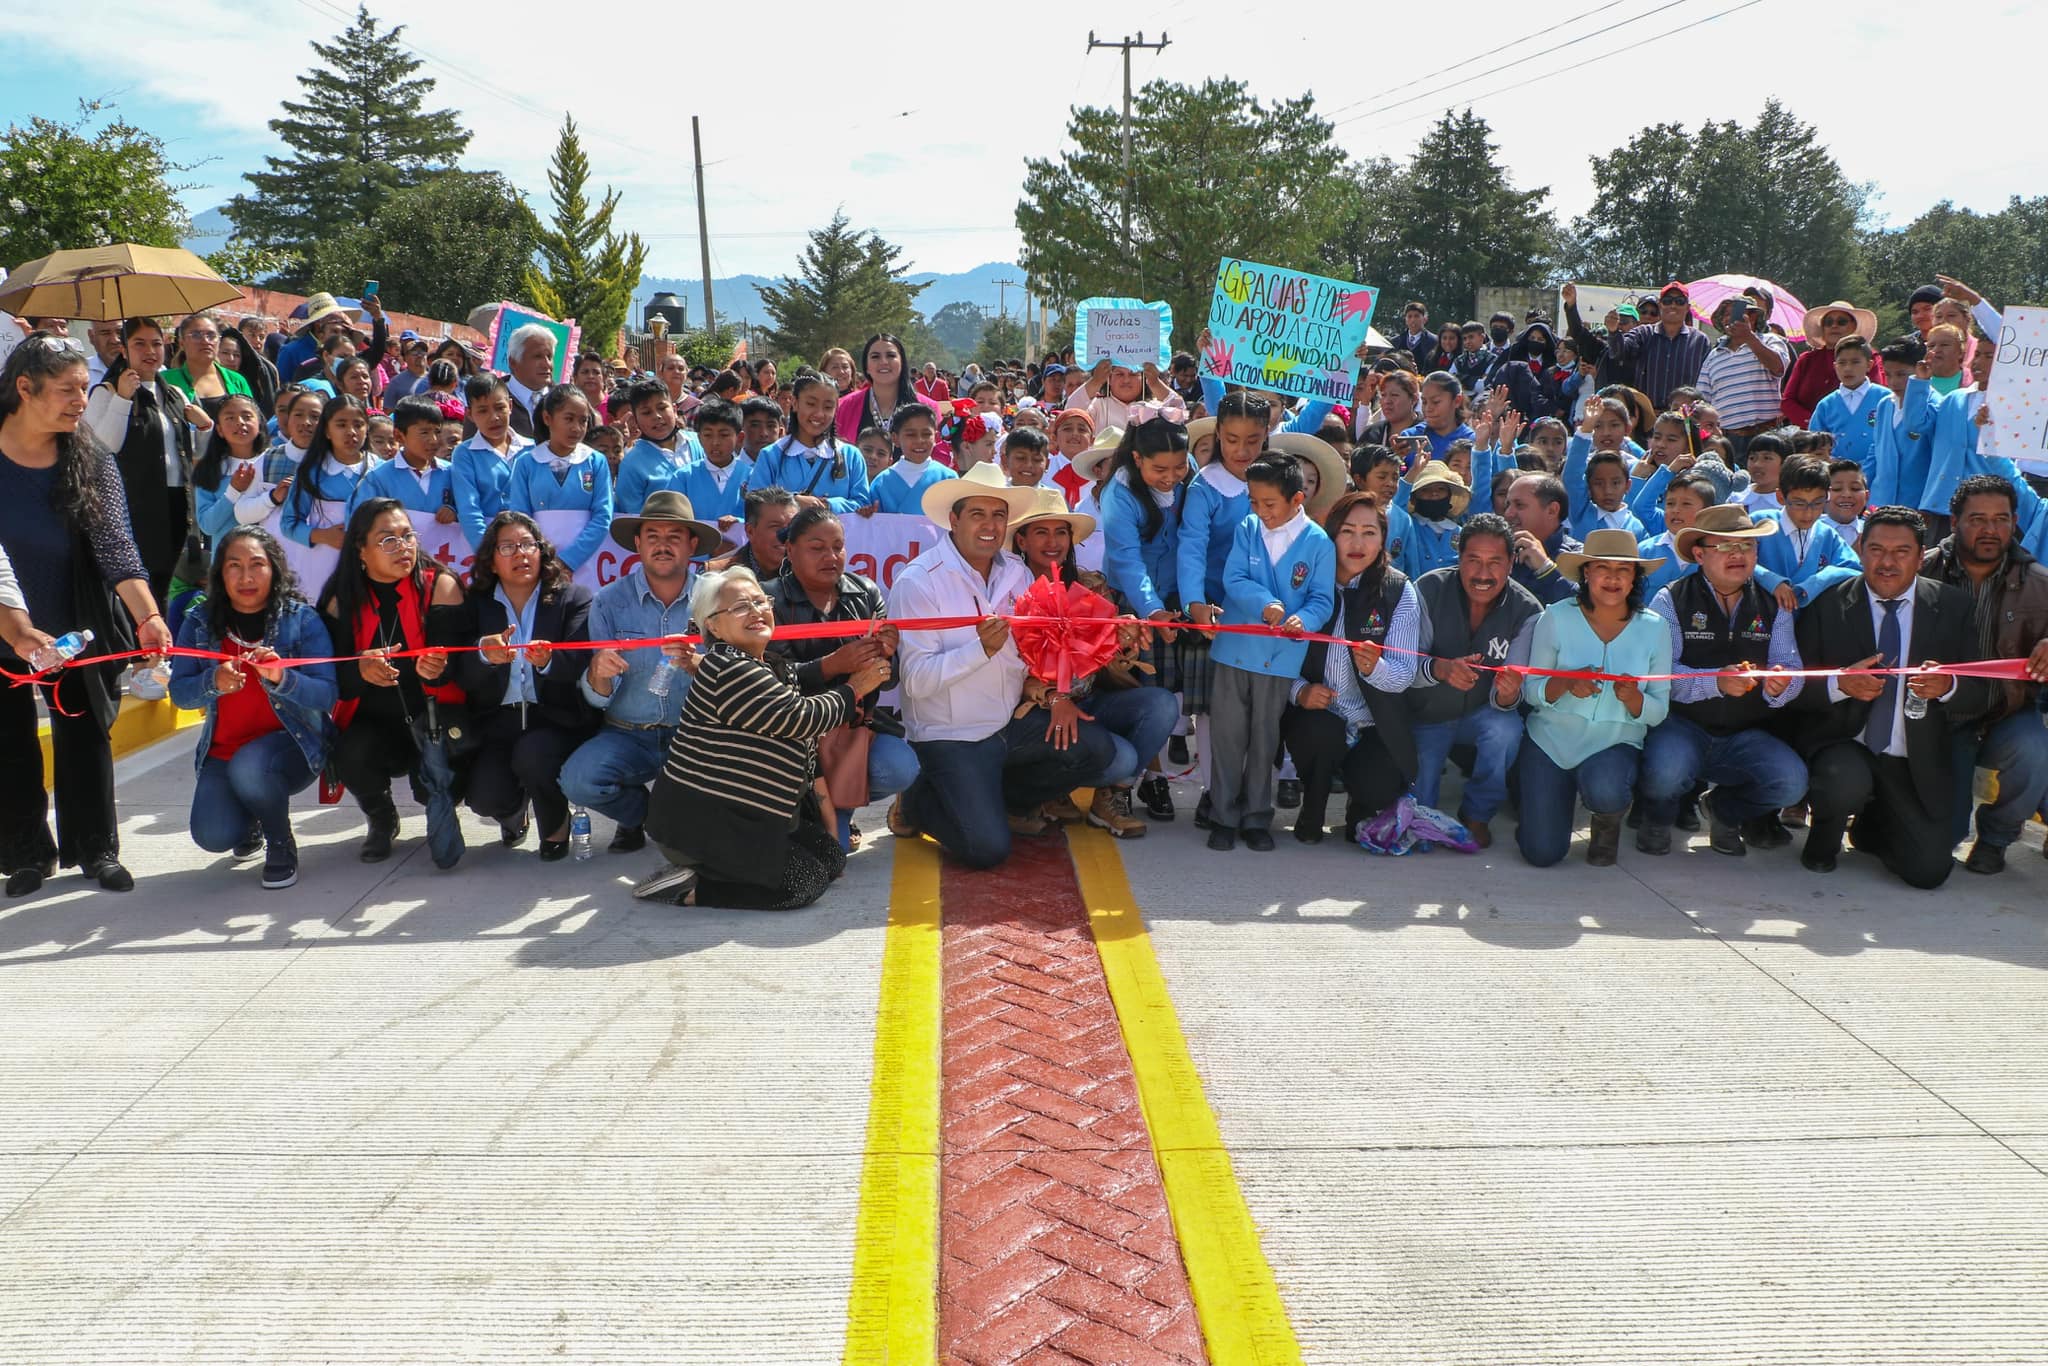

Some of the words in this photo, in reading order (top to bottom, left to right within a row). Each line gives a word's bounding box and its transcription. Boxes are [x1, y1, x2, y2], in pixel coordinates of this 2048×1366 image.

[1223, 260, 1308, 314] GRACIAS
[1312, 282, 1349, 326] POR
[1095, 311, 1141, 327] Muchas
[1211, 295, 1234, 326] SU
[1235, 306, 1287, 339] APOYO
[1287, 318, 1300, 343] A
[1305, 323, 1343, 355] ESTA
[1105, 330, 1140, 340] Gracias
[1487, 636, 1510, 660] NY
